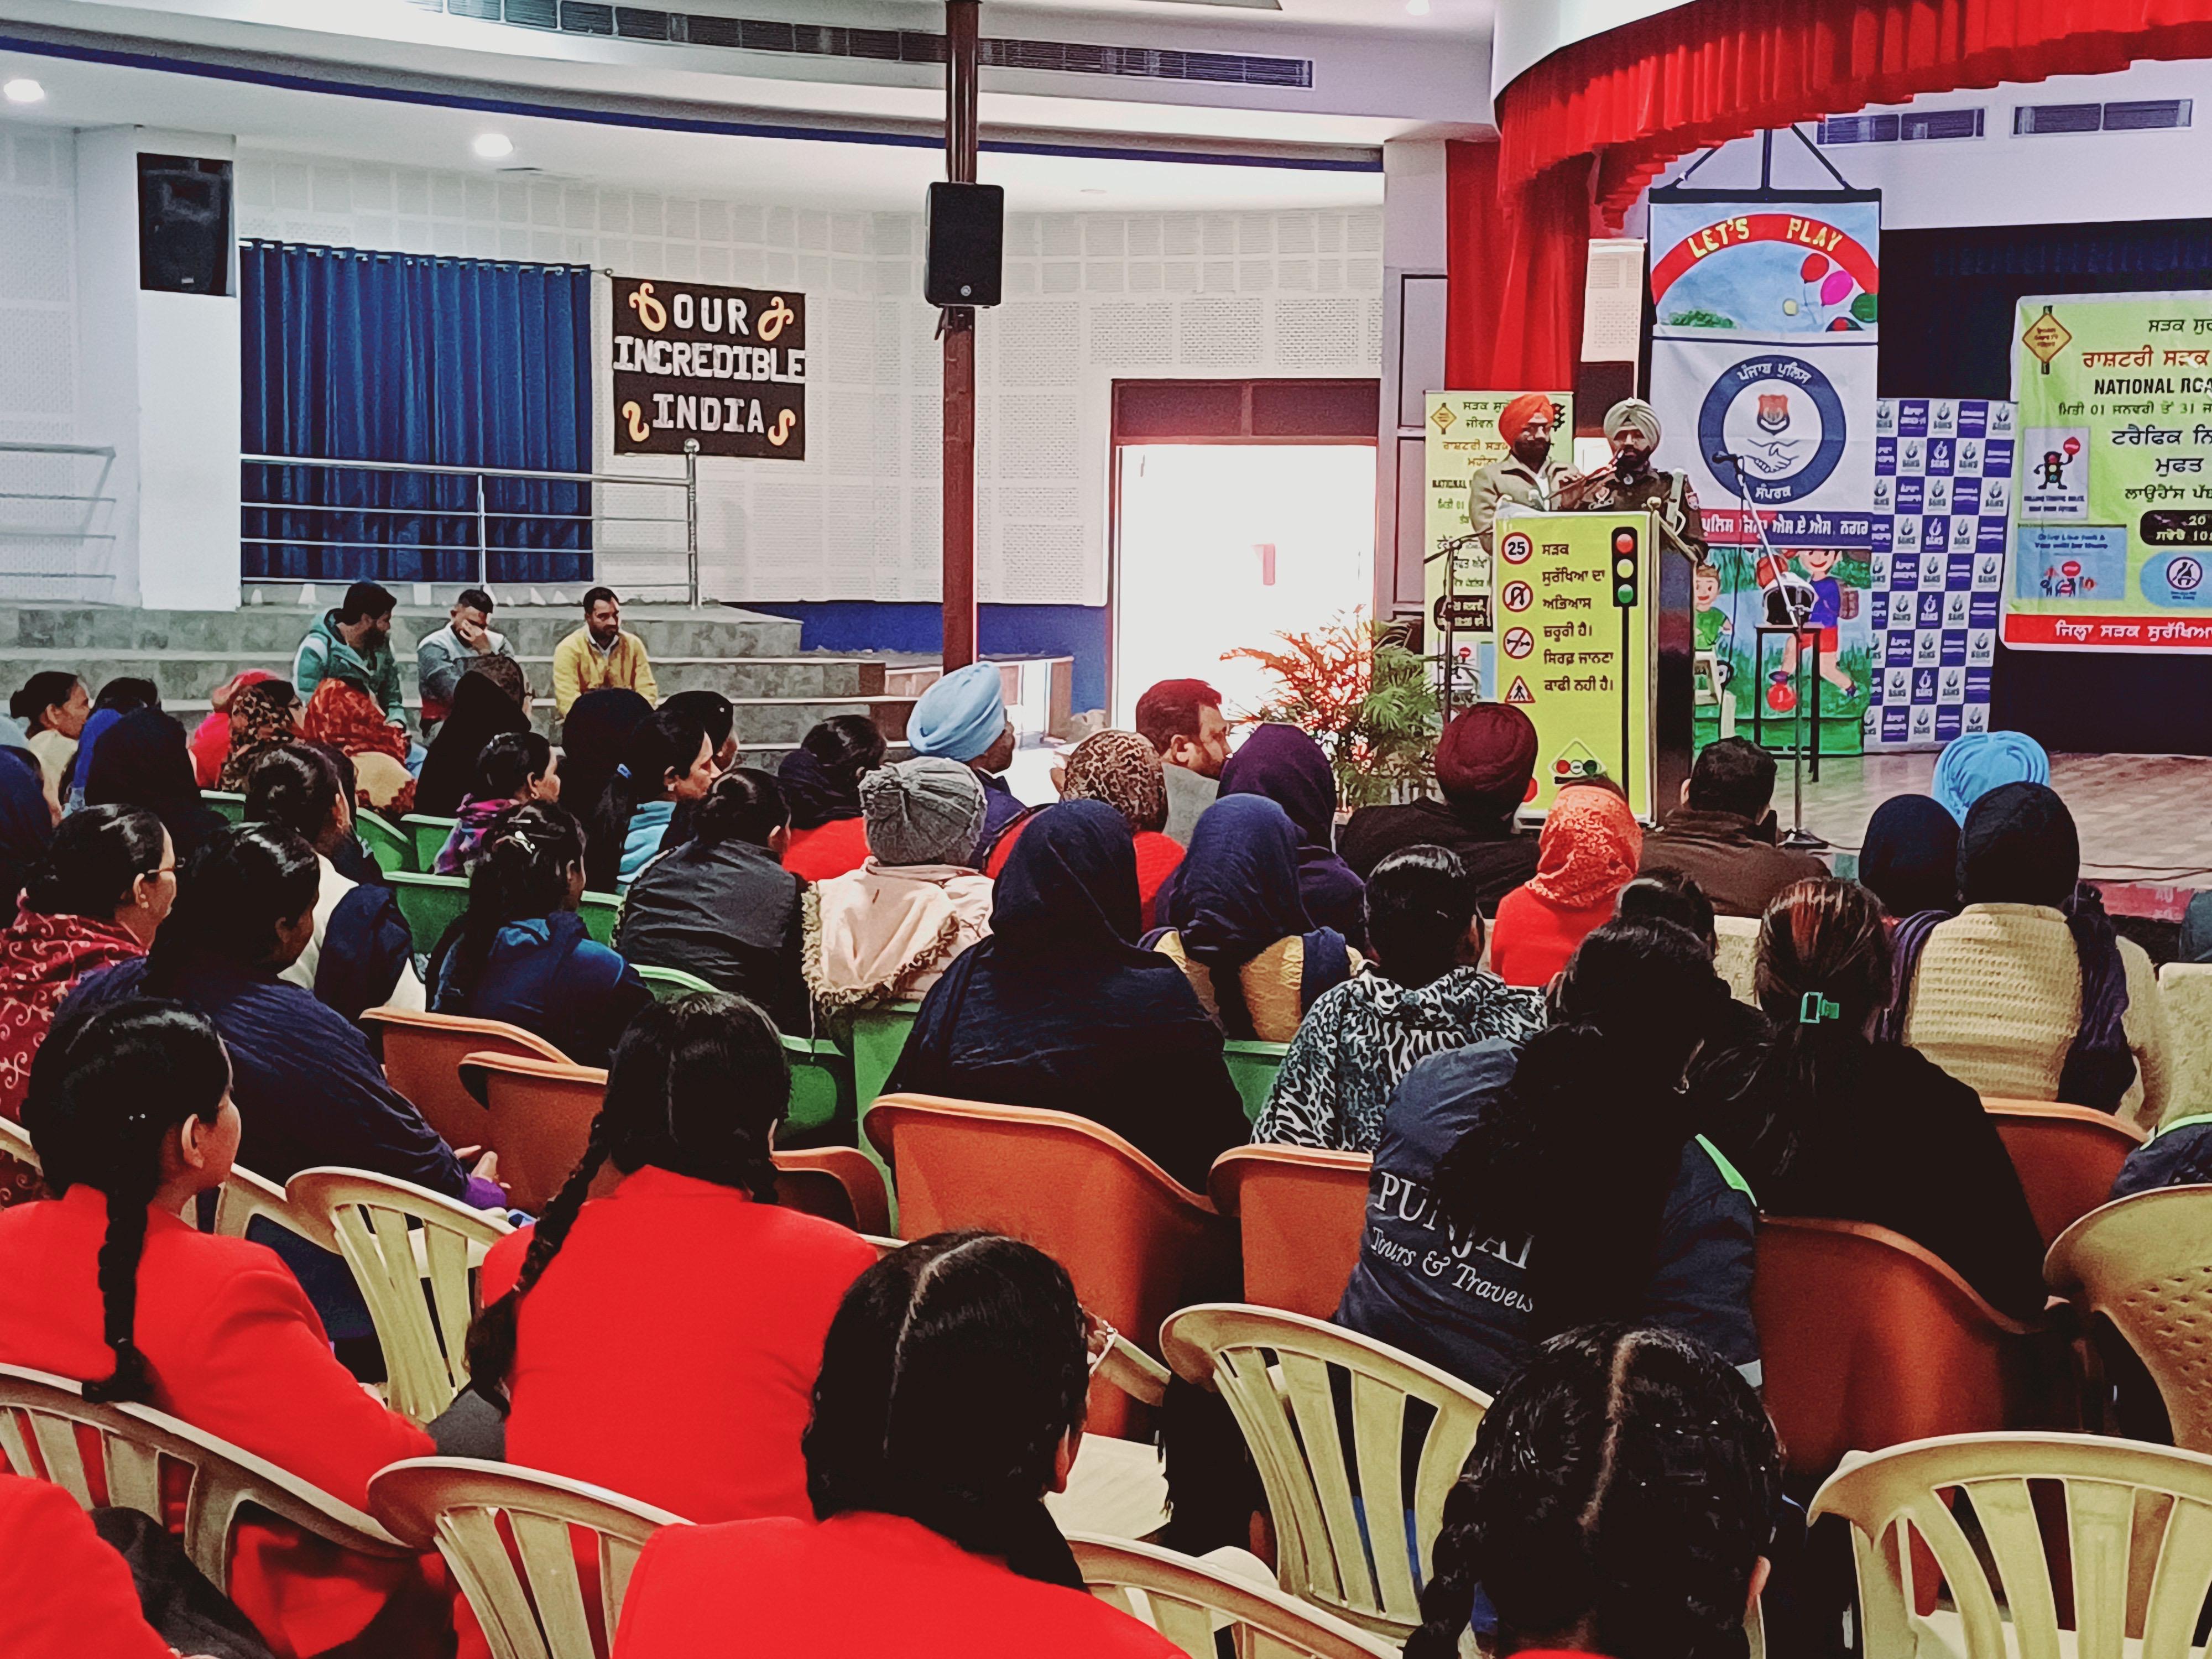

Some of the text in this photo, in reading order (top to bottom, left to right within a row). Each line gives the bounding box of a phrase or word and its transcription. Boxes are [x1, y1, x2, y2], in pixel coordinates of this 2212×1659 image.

[1687, 217, 1843, 258] LET'S PLAY
[673, 294, 749, 335] OUR
[613, 335, 805, 384] INCREDIBLE
[2094, 378, 2175, 394] NATIONAL
[653, 393, 765, 434] INDIA
[1507, 541, 1526, 555] 25
[1370, 1226, 1416, 1267] Tours
[1422, 1250, 1451, 1277] &
